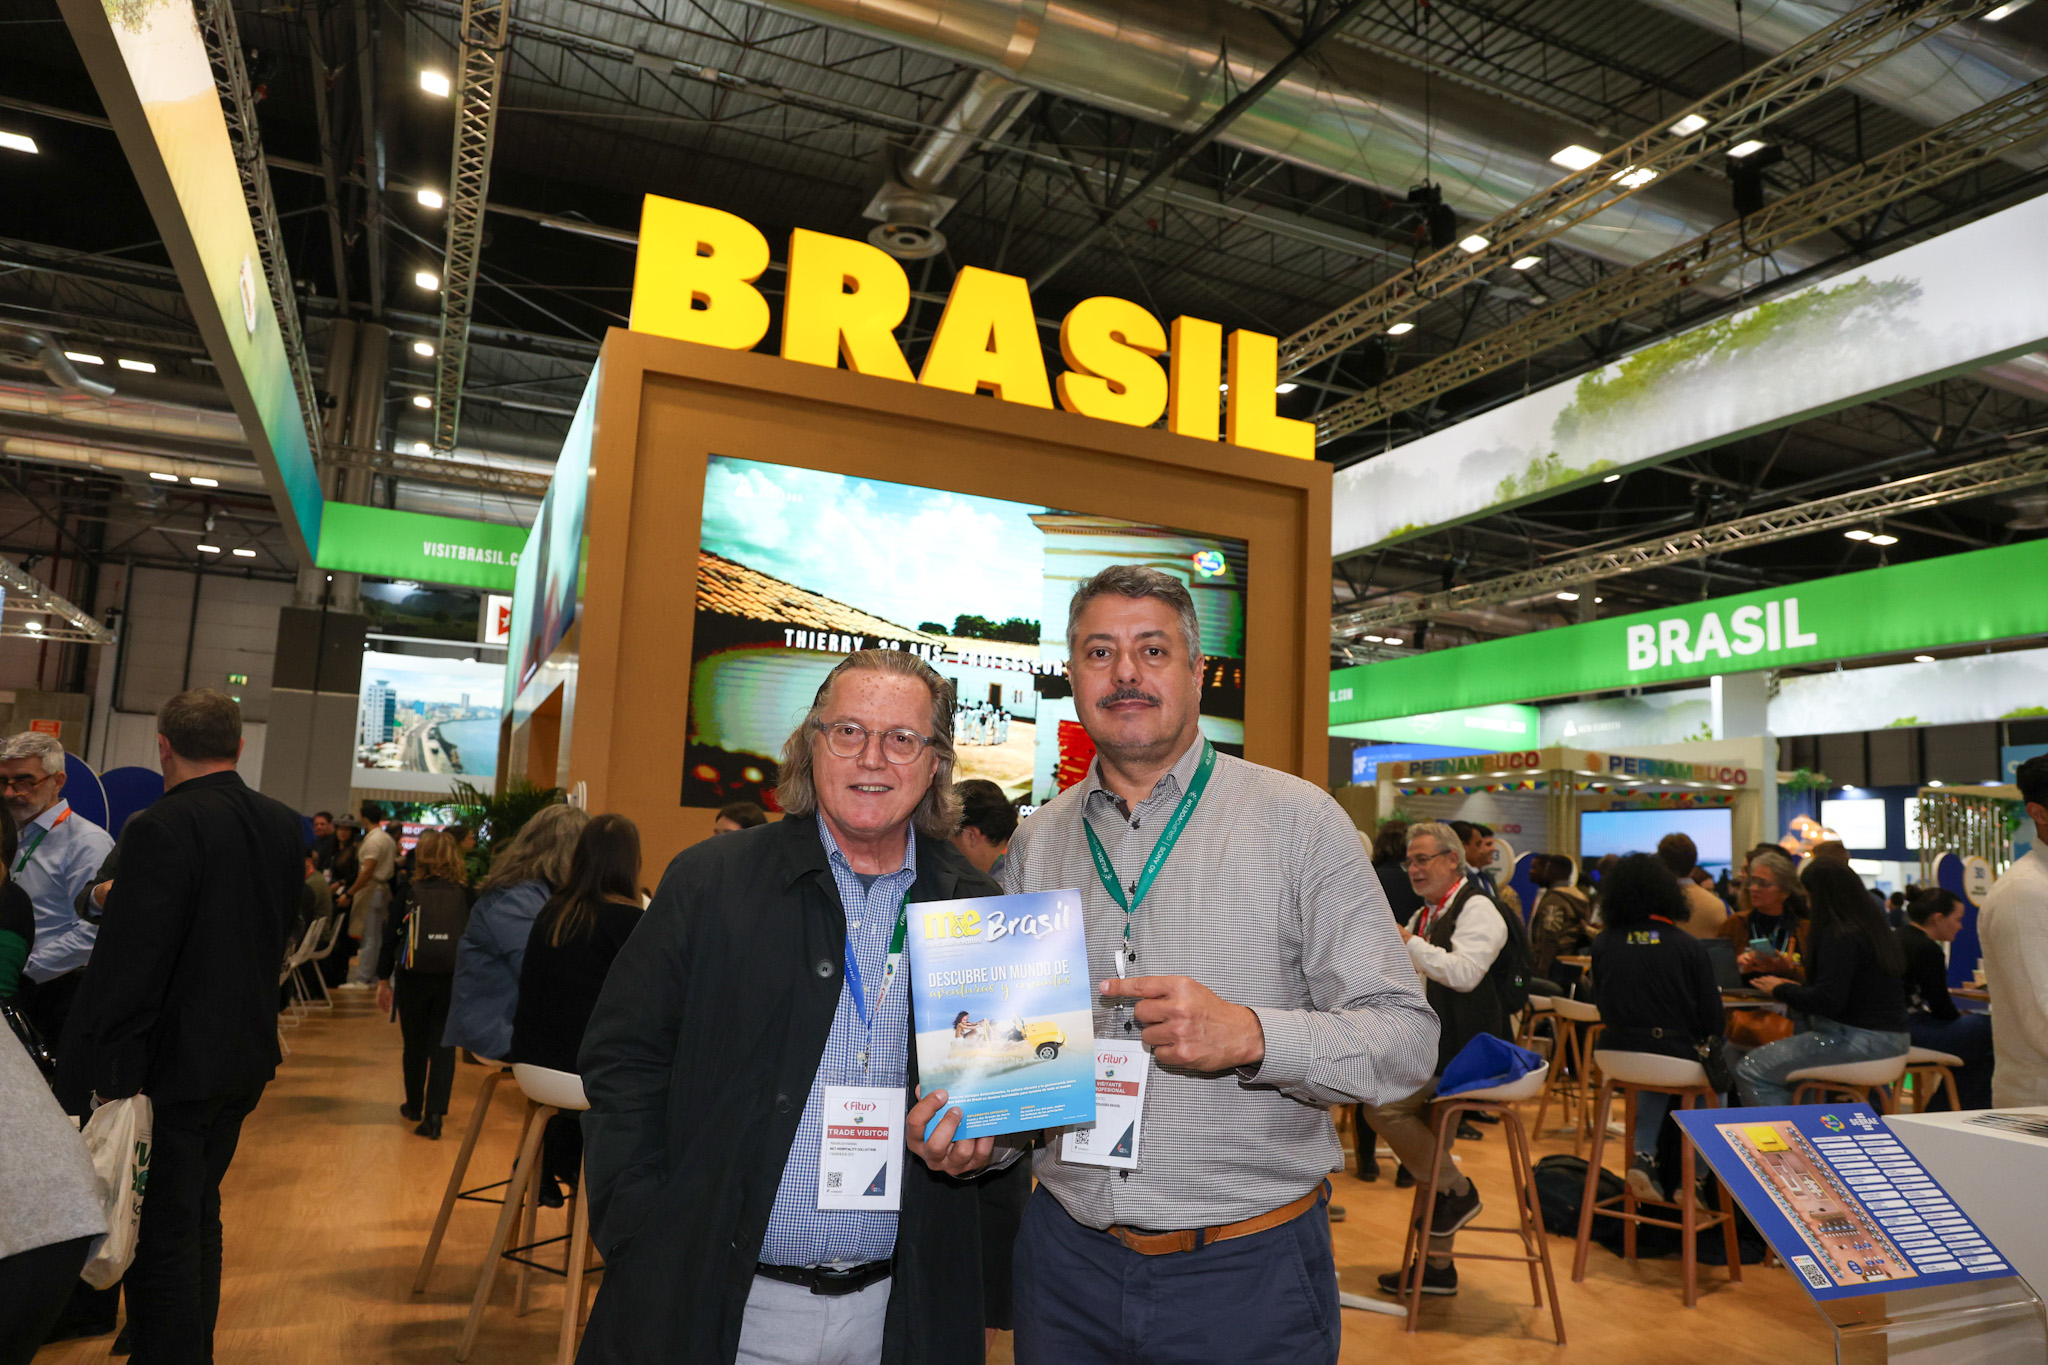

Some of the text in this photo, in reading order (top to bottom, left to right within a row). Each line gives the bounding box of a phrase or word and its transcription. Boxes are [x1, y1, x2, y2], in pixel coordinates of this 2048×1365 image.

[629, 192, 1316, 462] BRASIL
[784, 629, 864, 653] THIERRY
[1627, 597, 1817, 671] BRASIL
[1409, 751, 1540, 776] PERNAMBUCO
[1609, 755, 1748, 785] PERNAMBUCO
[1148, 865, 1156, 874] 40
[1153, 846, 1166, 864] ANOS
[986, 900, 1070, 943] Brasil
[928, 959, 1070, 988] DESCUBRE UN MUNDO DE
[929, 973, 1071, 1001] aventuras y encantos
[850, 1101, 870, 1111] Fitur
[828, 1128, 889, 1137] TRADE VISITOR
[1849, 1117, 1880, 1126] SEBRAE
